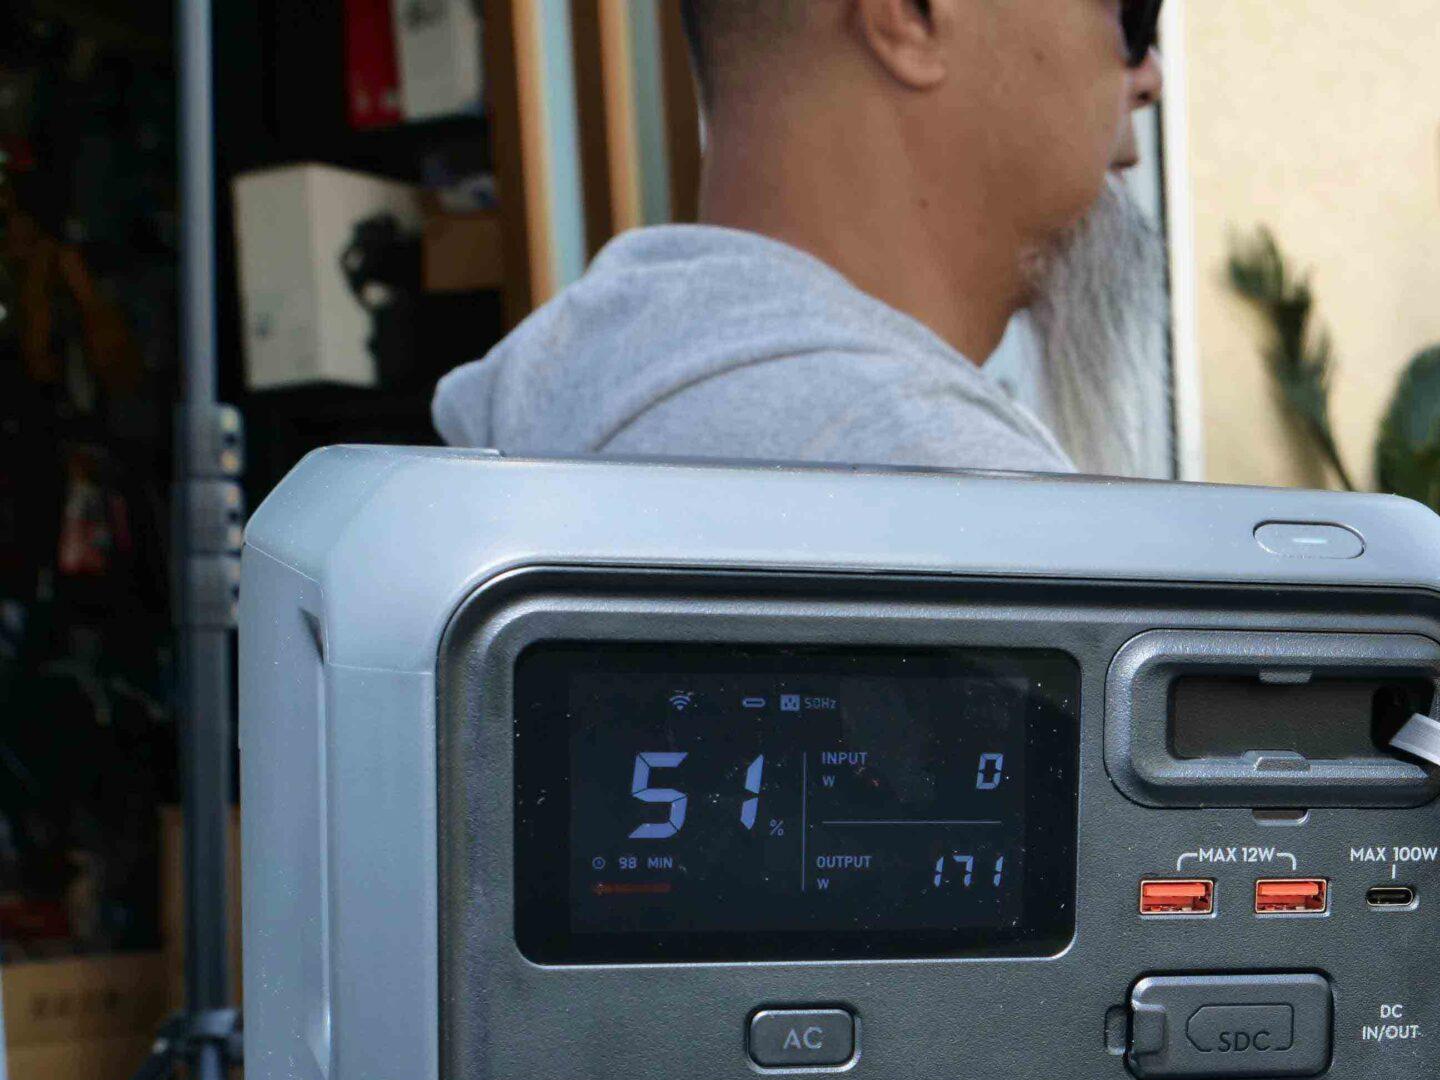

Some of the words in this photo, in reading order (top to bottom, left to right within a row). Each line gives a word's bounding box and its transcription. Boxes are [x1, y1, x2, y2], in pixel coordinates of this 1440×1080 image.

[822, 752, 868, 765] INPUT
[976, 752, 1003, 789] 0
[822, 775, 836, 787] W
[816, 855, 872, 868] OUTPUT
[1199, 848, 1237, 862] MAX
[1242, 847, 1275, 862] 12W
[1350, 847, 1386, 862] MAX
[1393, 847, 1438, 861] 100W
[647, 857, 673, 869] MIN
[934, 855, 1003, 887] 171
[817, 878, 829, 889] W
[1380, 1004, 1402, 1018] DC
[783, 1026, 823, 1049] AC
[1362, 1025, 1419, 1041] IN/OUT
[1218, 1031, 1271, 1051] SDC
